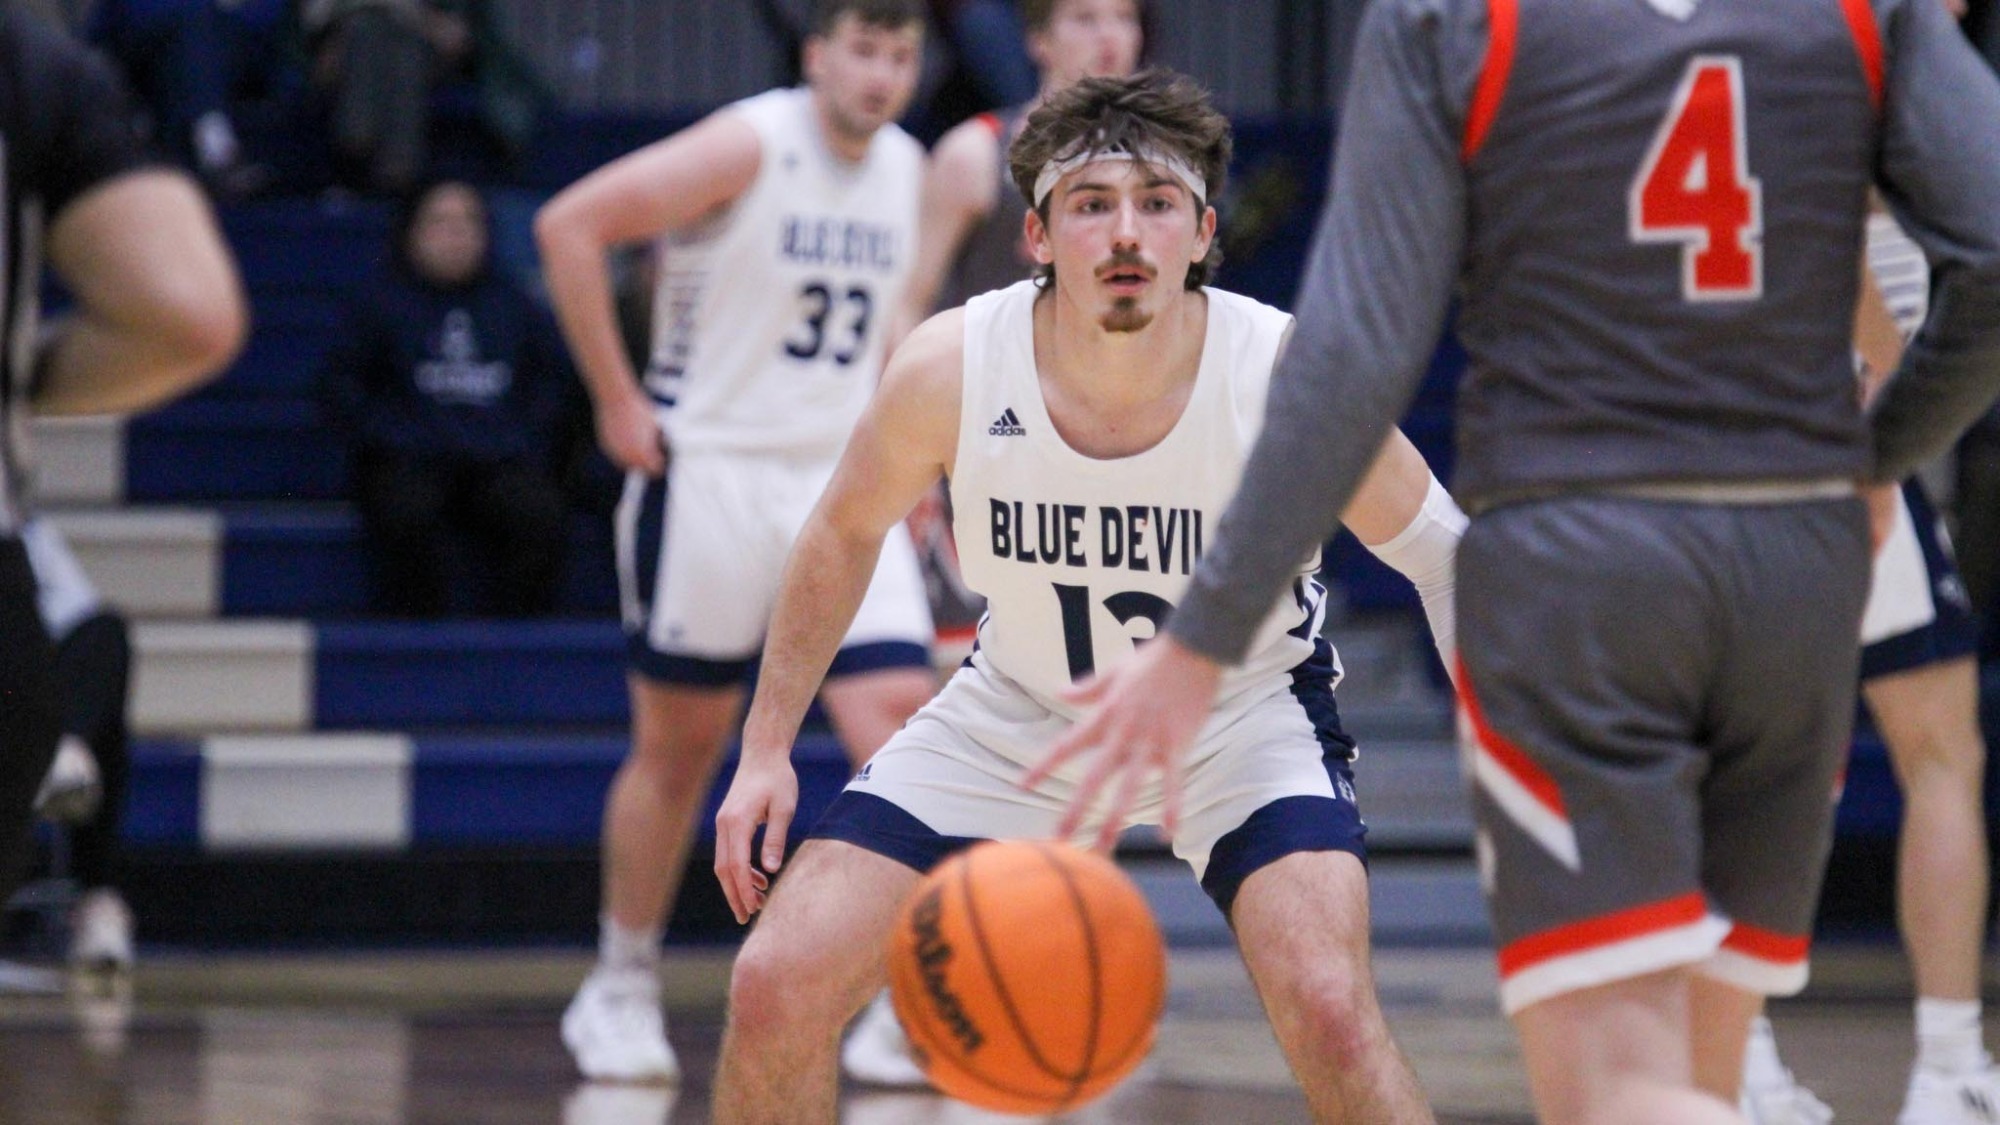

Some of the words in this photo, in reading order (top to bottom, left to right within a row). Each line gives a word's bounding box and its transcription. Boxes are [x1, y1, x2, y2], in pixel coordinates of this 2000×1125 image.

[1629, 55, 1763, 301] 4
[783, 281, 874, 367] 33
[988, 425, 1026, 436] adidas
[989, 497, 1088, 567] BLUE
